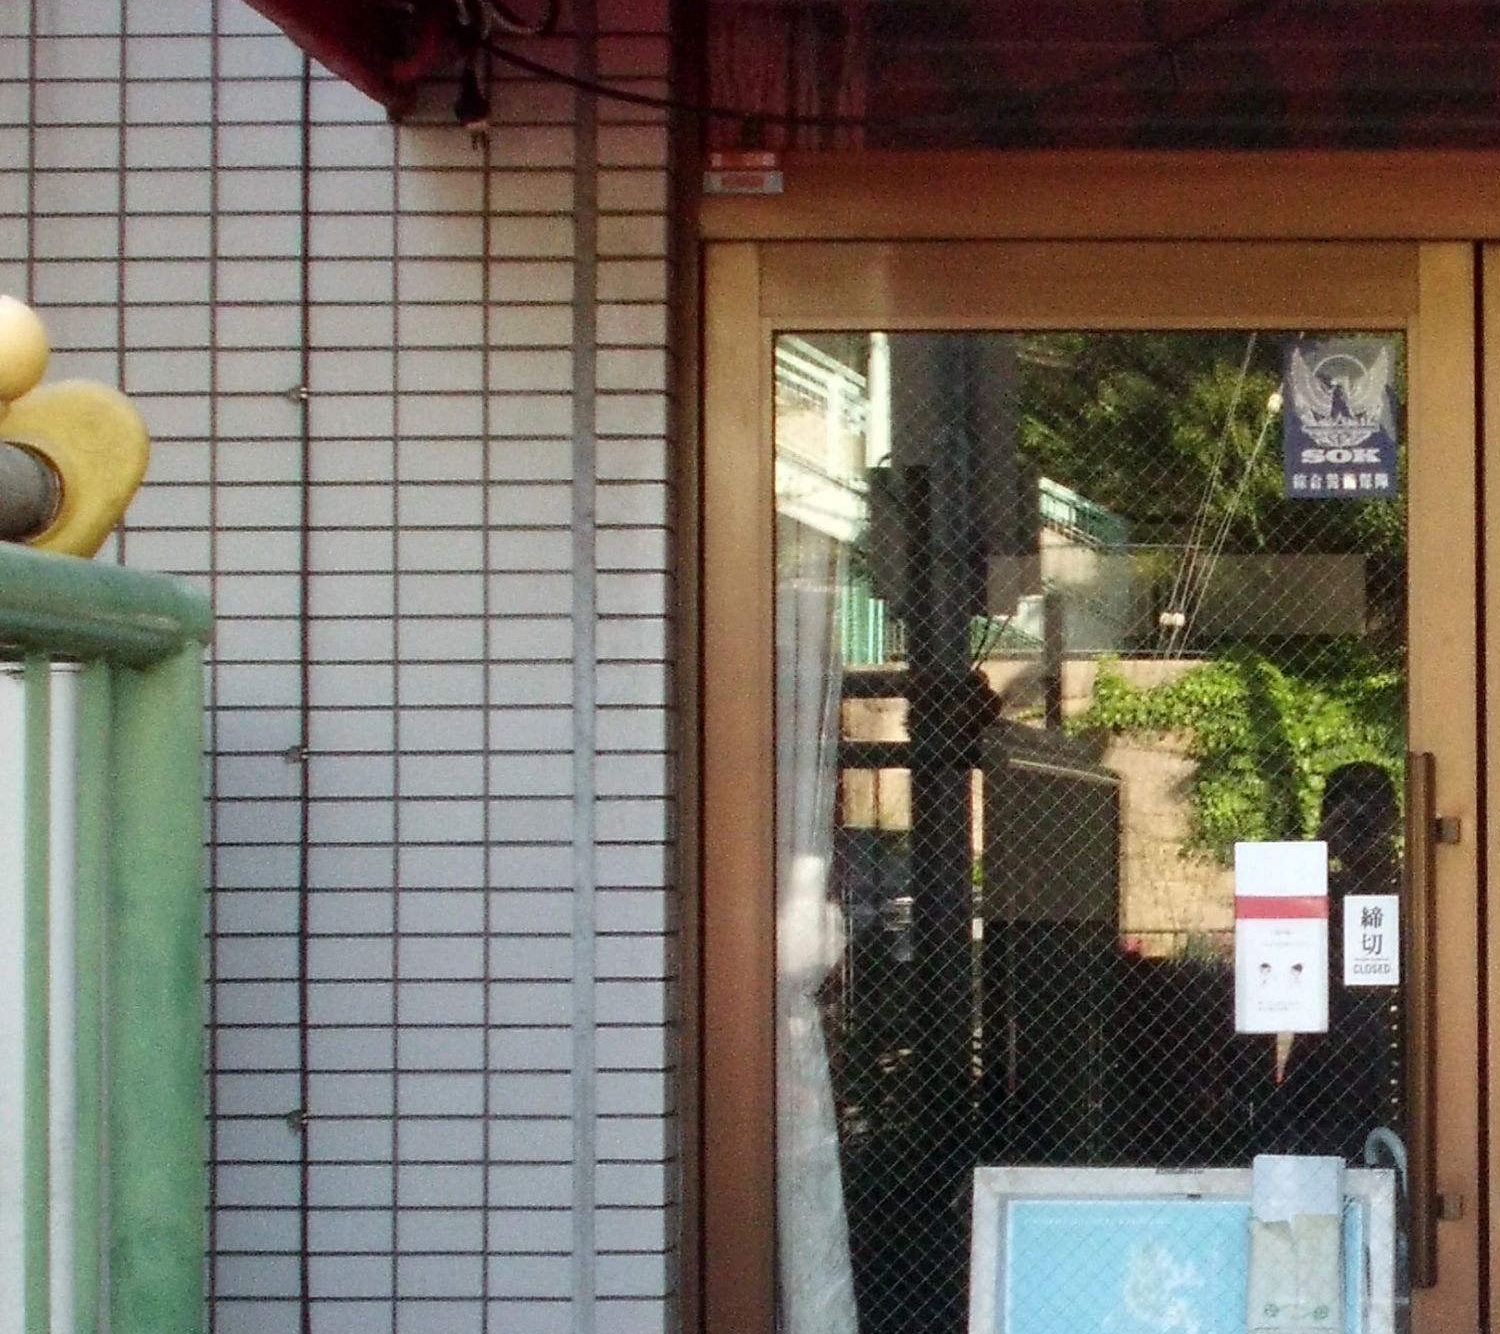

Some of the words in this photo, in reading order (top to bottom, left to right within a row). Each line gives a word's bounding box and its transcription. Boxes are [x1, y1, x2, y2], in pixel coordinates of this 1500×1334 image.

[1301, 448, 1381, 463] SOK
[1361, 906, 1384, 956] 締切
[1353, 964, 1391, 974] CLOSED
